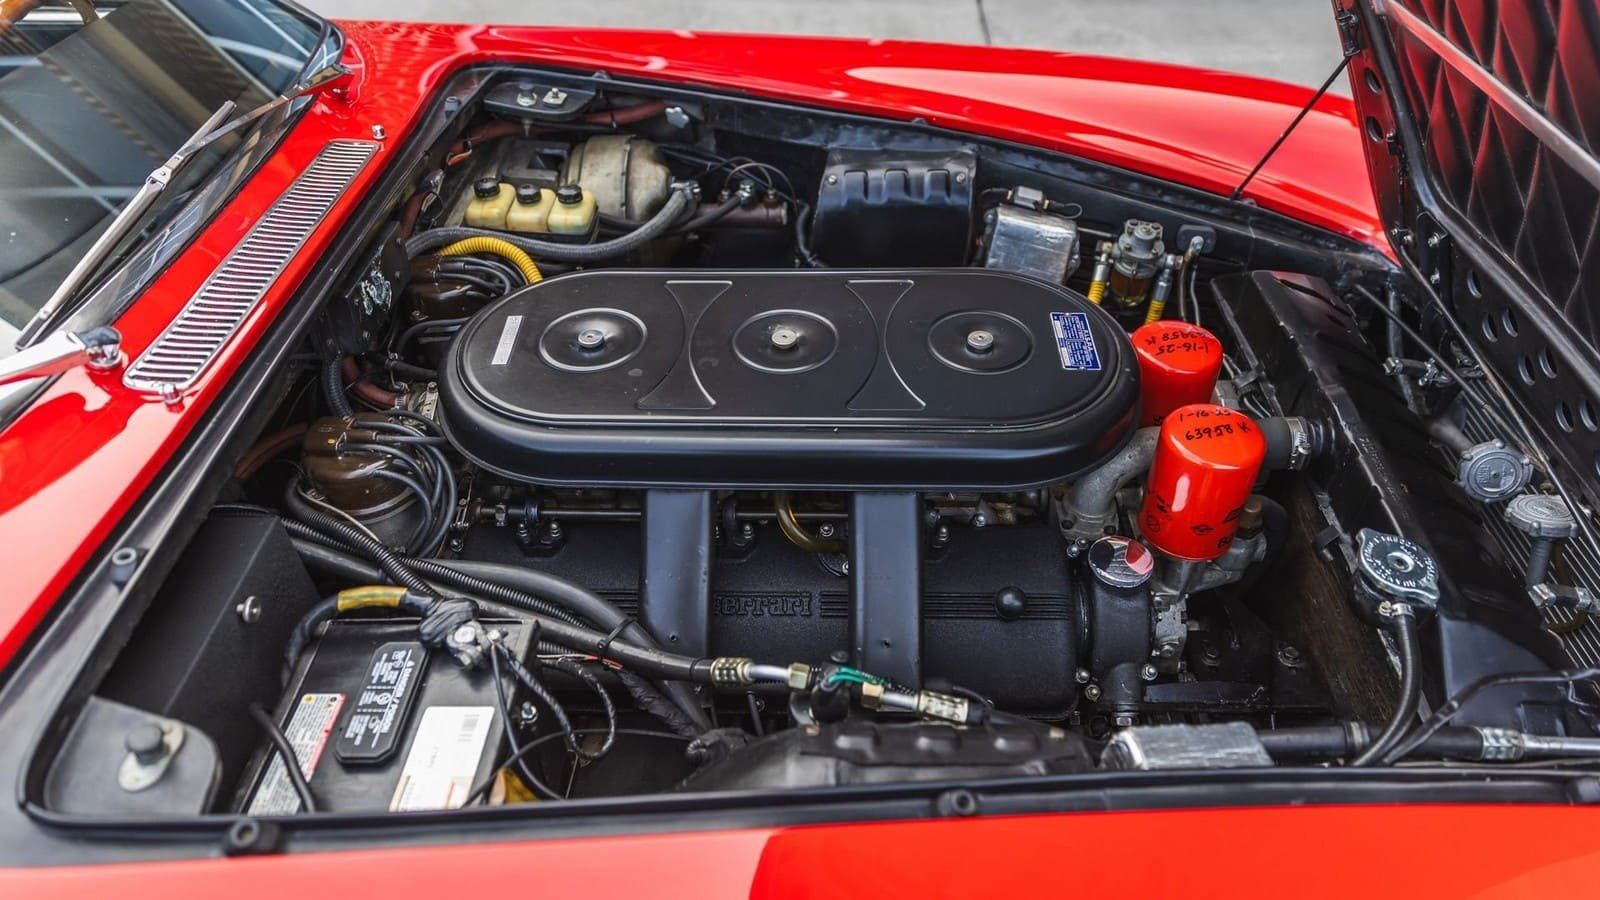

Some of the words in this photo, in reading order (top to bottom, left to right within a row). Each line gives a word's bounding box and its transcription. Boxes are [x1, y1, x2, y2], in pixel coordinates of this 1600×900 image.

[1156, 342, 1209, 355] 1-16-25
[1178, 408, 1232, 421] 1-16-25
[1185, 423, 1233, 440] 63958
